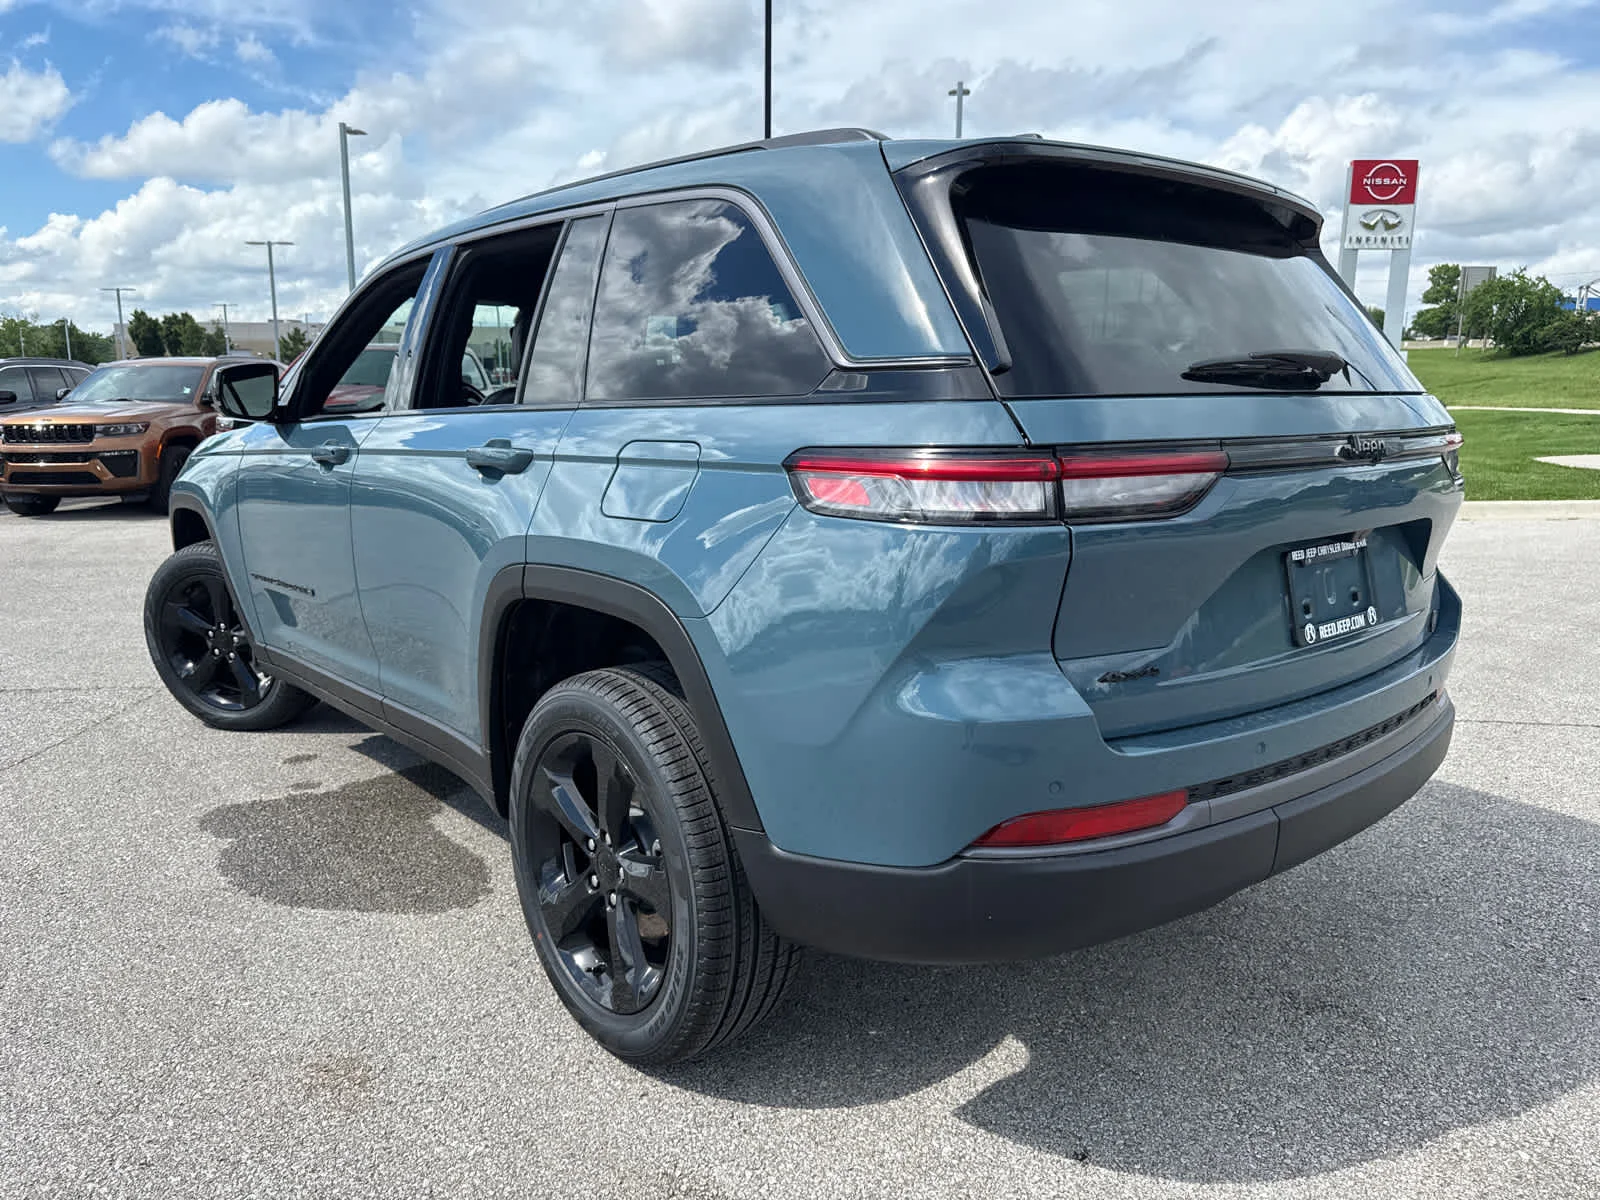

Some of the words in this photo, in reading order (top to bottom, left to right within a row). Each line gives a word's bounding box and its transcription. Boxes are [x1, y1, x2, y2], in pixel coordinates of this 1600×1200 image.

[1349, 236, 1409, 244] INFINITI
[1291, 550, 1305, 561] REED
[1306, 548, 1317, 558] JEEP
[1317, 543, 1341, 556] CHRYSLER
[1319, 615, 1365, 639] REEDJEEP.COM
